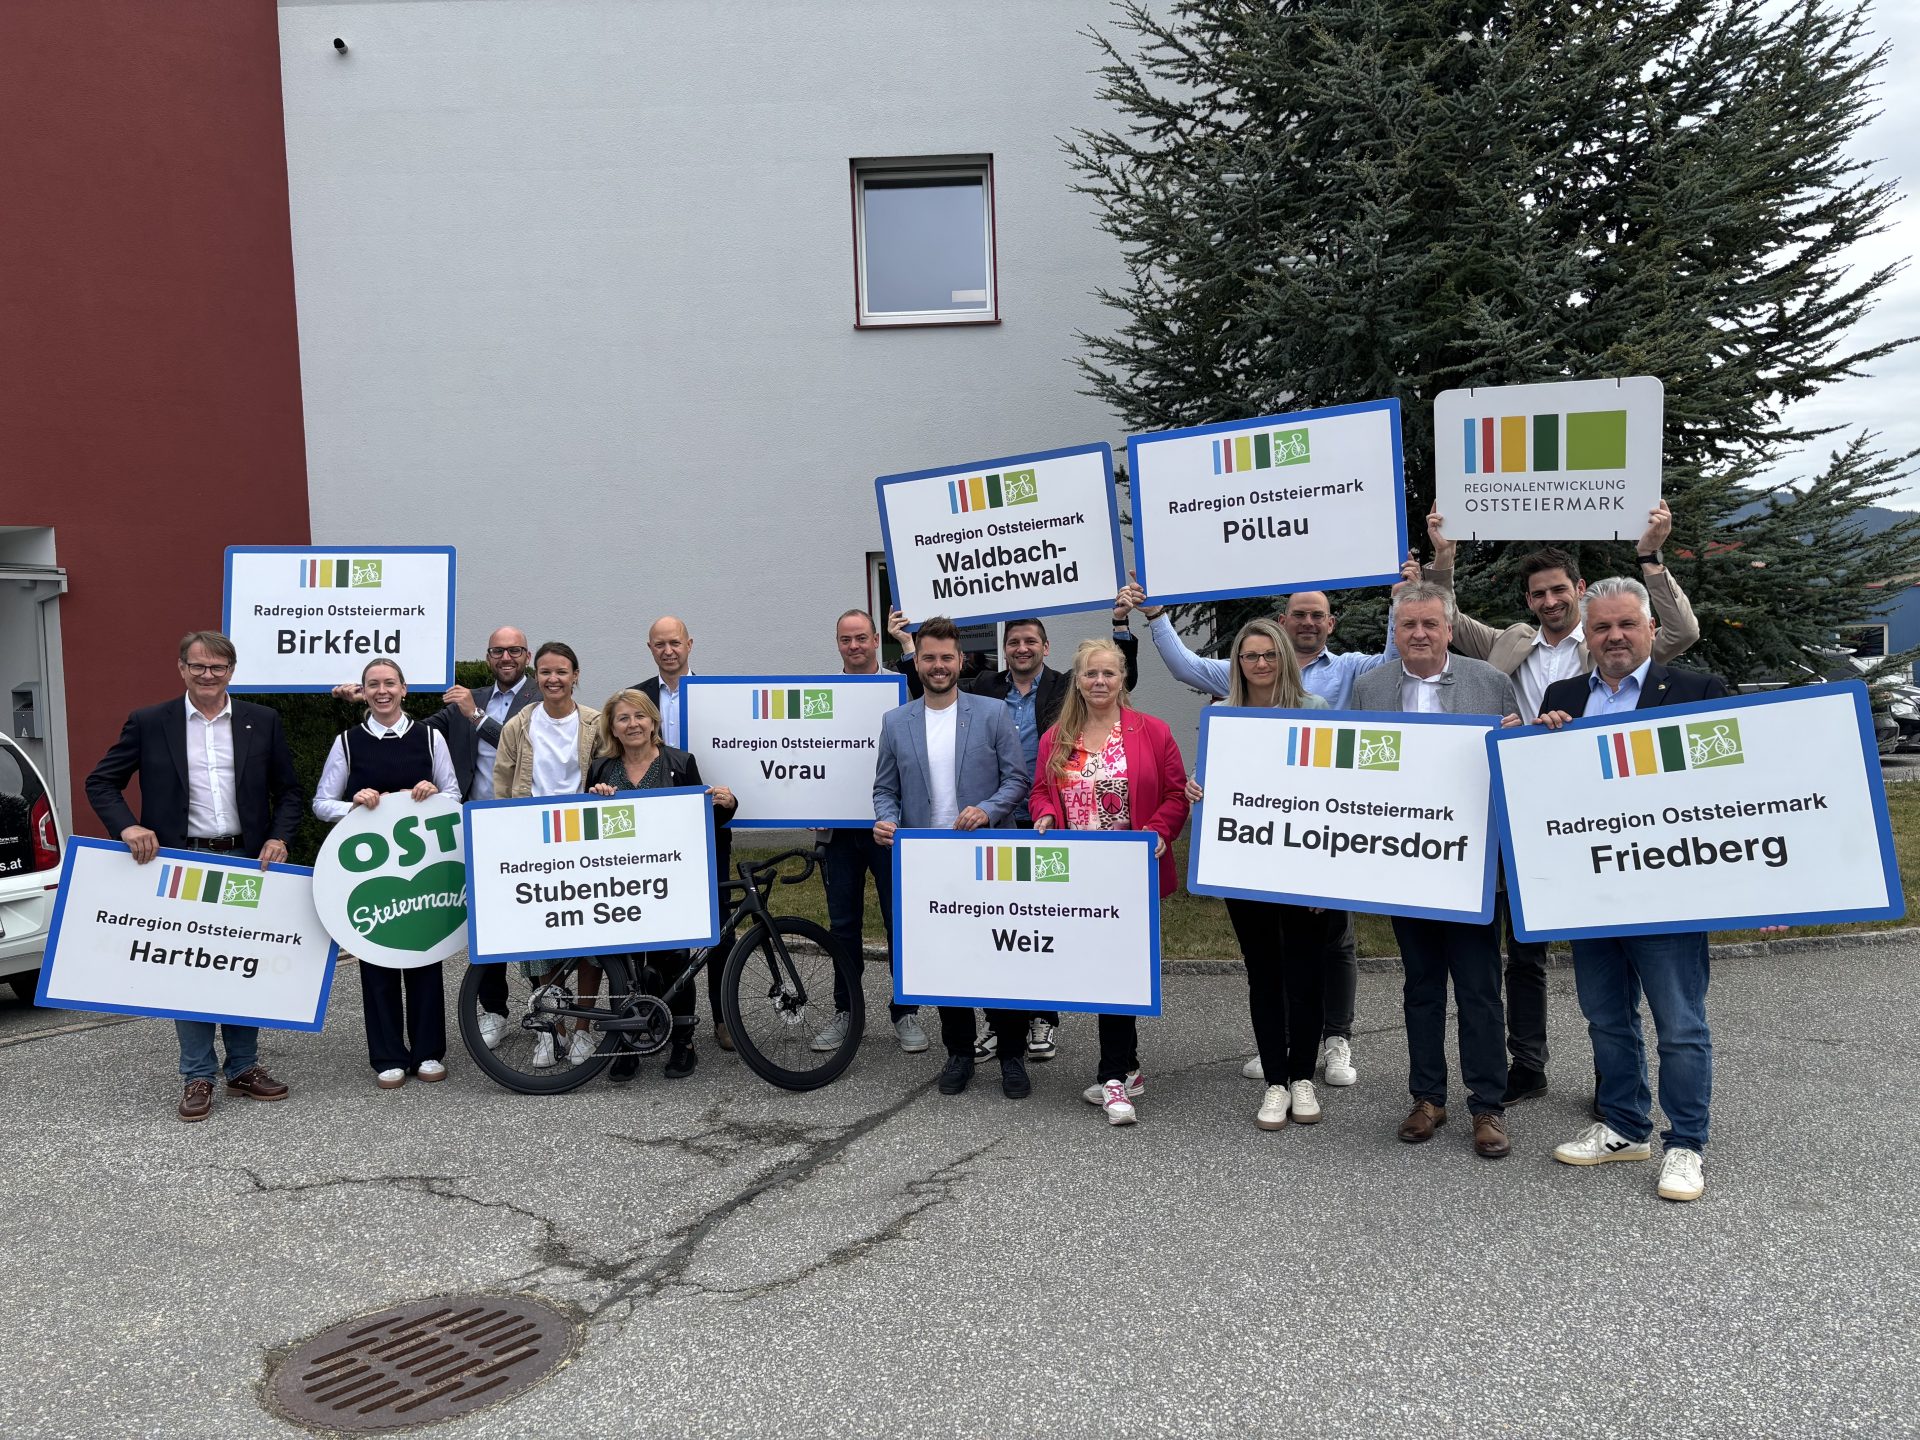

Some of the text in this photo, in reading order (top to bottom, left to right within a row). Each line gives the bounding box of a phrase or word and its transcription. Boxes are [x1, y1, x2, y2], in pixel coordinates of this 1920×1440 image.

[1169, 479, 1364, 514] Radregion Oststeiermark
[1465, 480, 1625, 493] REGIONALENTWICKLUNG
[1465, 496, 1624, 512] OSTSTEIERMARK
[914, 512, 1084, 546] Radregion Oststeiermark
[1223, 516, 1308, 543] Pöllau
[936, 539, 1067, 574] Waldbach-
[932, 561, 1079, 600] Mönichwald
[254, 605, 425, 619] Radregion Oststeiermark
[278, 629, 400, 654] Birkfeld
[712, 737, 875, 751] Radregion Oststeiermark
[760, 760, 825, 779] Vorau
[1233, 792, 1454, 821] Radregion Oststeiermark
[1546, 793, 1828, 836] Radregion Oststeiermark
[338, 812, 461, 873] OST
[1218, 817, 1468, 861] Bad Loipersdorf
[500, 850, 681, 874] Radregion Oststeiermark
[1591, 836, 1788, 874] Friedberg
[516, 877, 668, 904] Stubenberg
[353, 884, 467, 936] Steiermark
[545, 903, 641, 928] am See
[930, 901, 1120, 919] Radregion Oststeiermark
[96, 910, 302, 945] Radregion Oststeiermark
[992, 929, 1054, 953] Weiz
[130, 940, 259, 978] Hartberg
